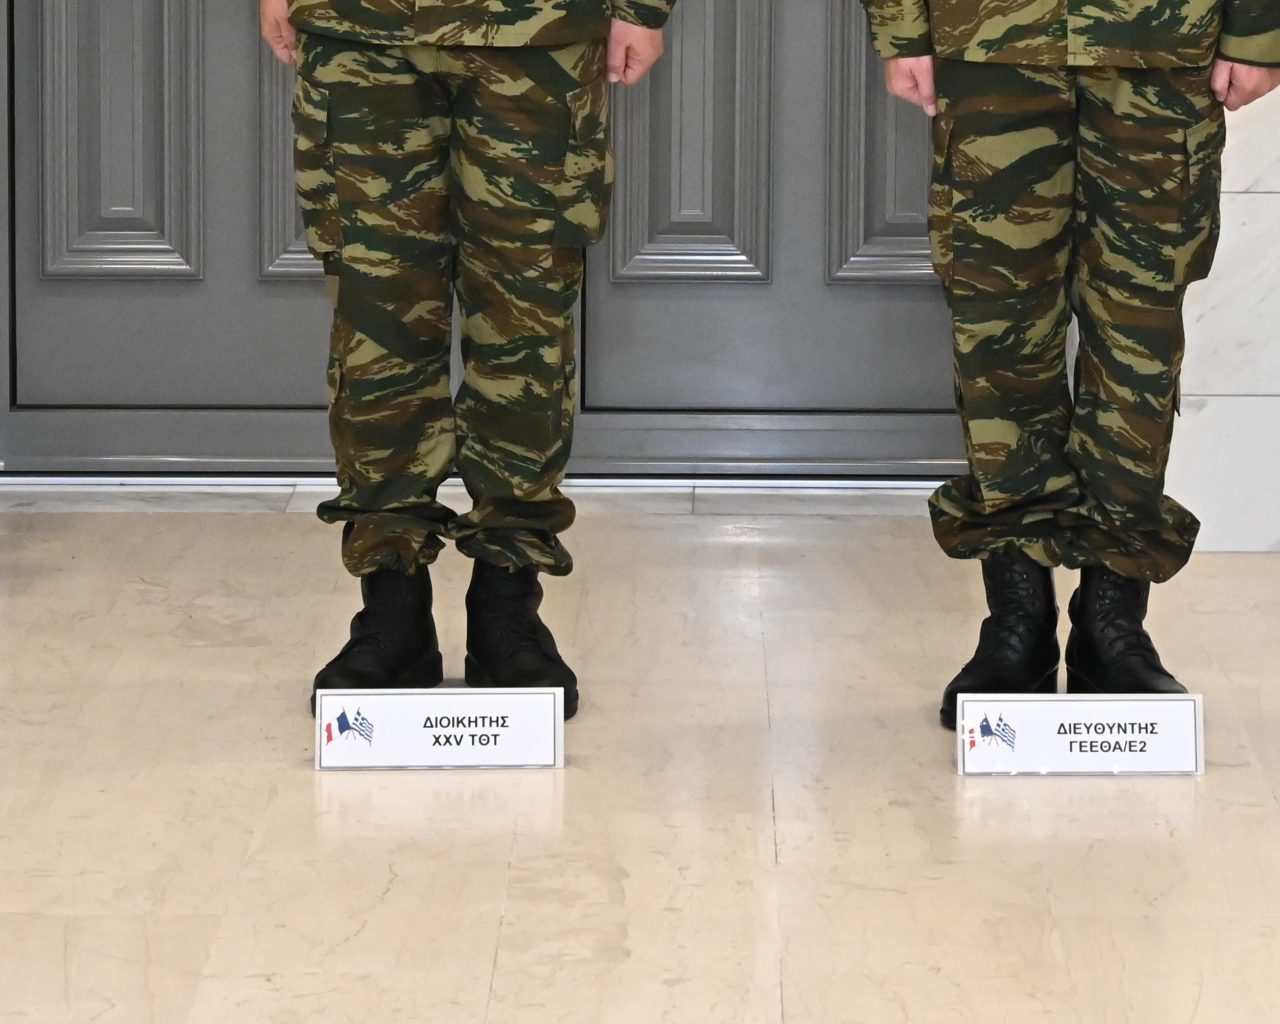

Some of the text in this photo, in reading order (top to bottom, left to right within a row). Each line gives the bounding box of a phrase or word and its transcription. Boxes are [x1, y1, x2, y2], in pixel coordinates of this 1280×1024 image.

[423, 715, 509, 729] ΔΙΟΙΚΗΤΗΣ
[1057, 722, 1159, 735] ΔΙΕΥΘΥΝΤΗΣ
[469, 733, 500, 746] ΤΘΤ
[1069, 740, 1147, 753] ΓΕΕΘΑ/Ε2
